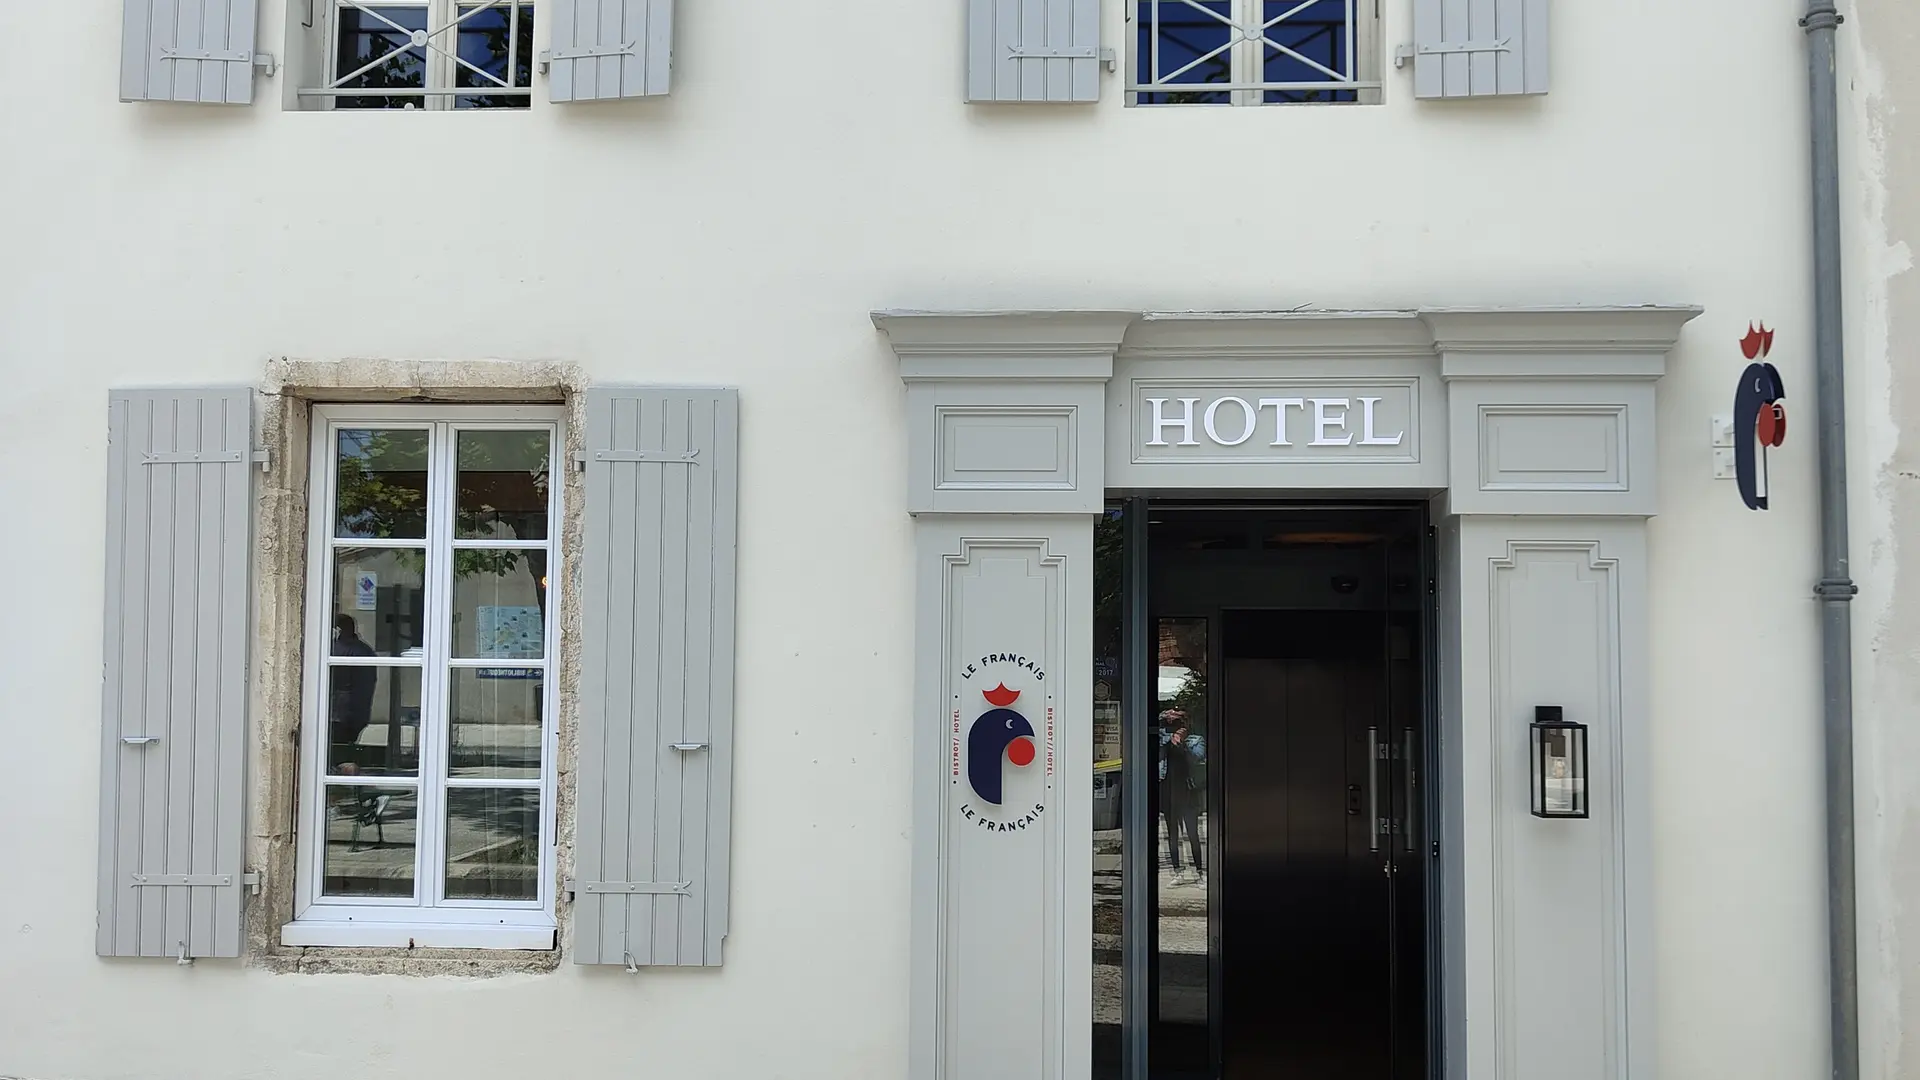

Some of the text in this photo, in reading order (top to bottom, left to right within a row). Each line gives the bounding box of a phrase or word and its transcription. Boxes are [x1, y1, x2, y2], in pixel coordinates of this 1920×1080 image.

[1145, 396, 1404, 446] HOTEL
[961, 652, 1045, 681] LE FRANÇAIS
[960, 802, 1045, 832] LE FRANÇAIS
